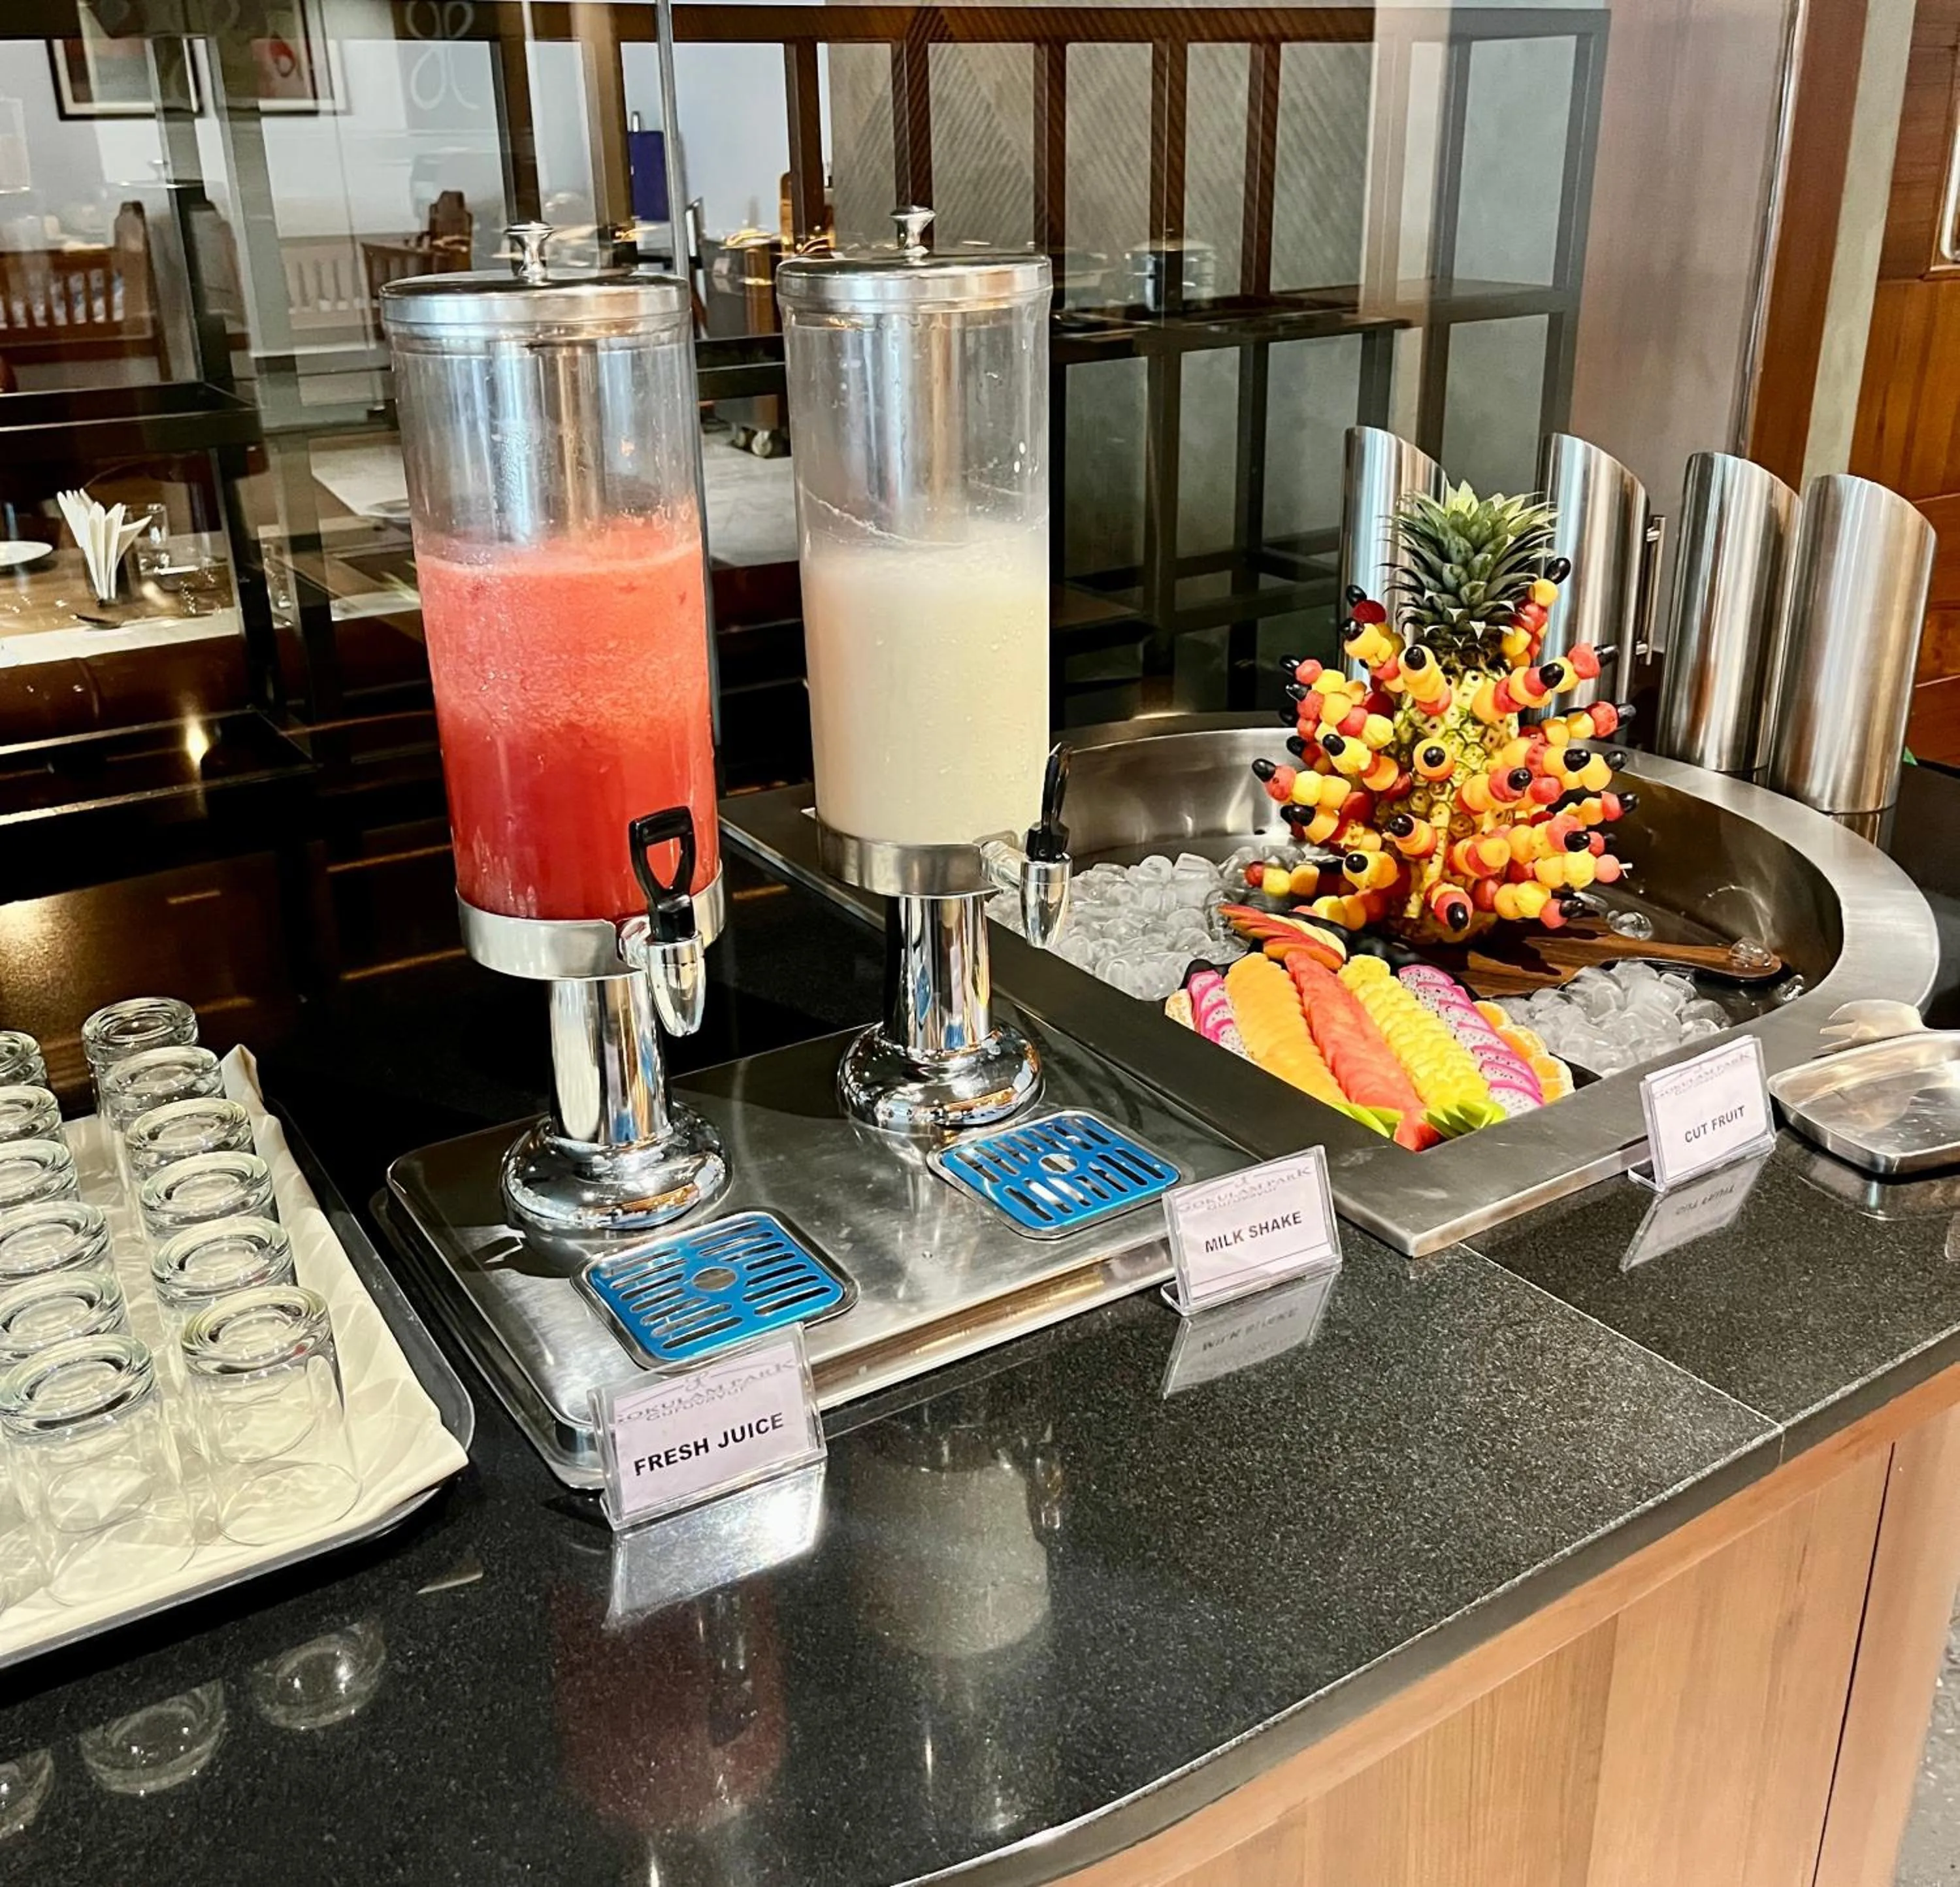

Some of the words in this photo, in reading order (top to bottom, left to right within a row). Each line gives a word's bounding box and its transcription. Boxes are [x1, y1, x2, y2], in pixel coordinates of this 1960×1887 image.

[1684, 1123, 1708, 1143] CUT
[1711, 1105, 1746, 1132] FRUIT
[1204, 1228, 1245, 1253] MILK
[1248, 1210, 1303, 1239] SHAKE
[633, 1437, 710, 1476] FRESH
[717, 1412, 784, 1449] JUICE
